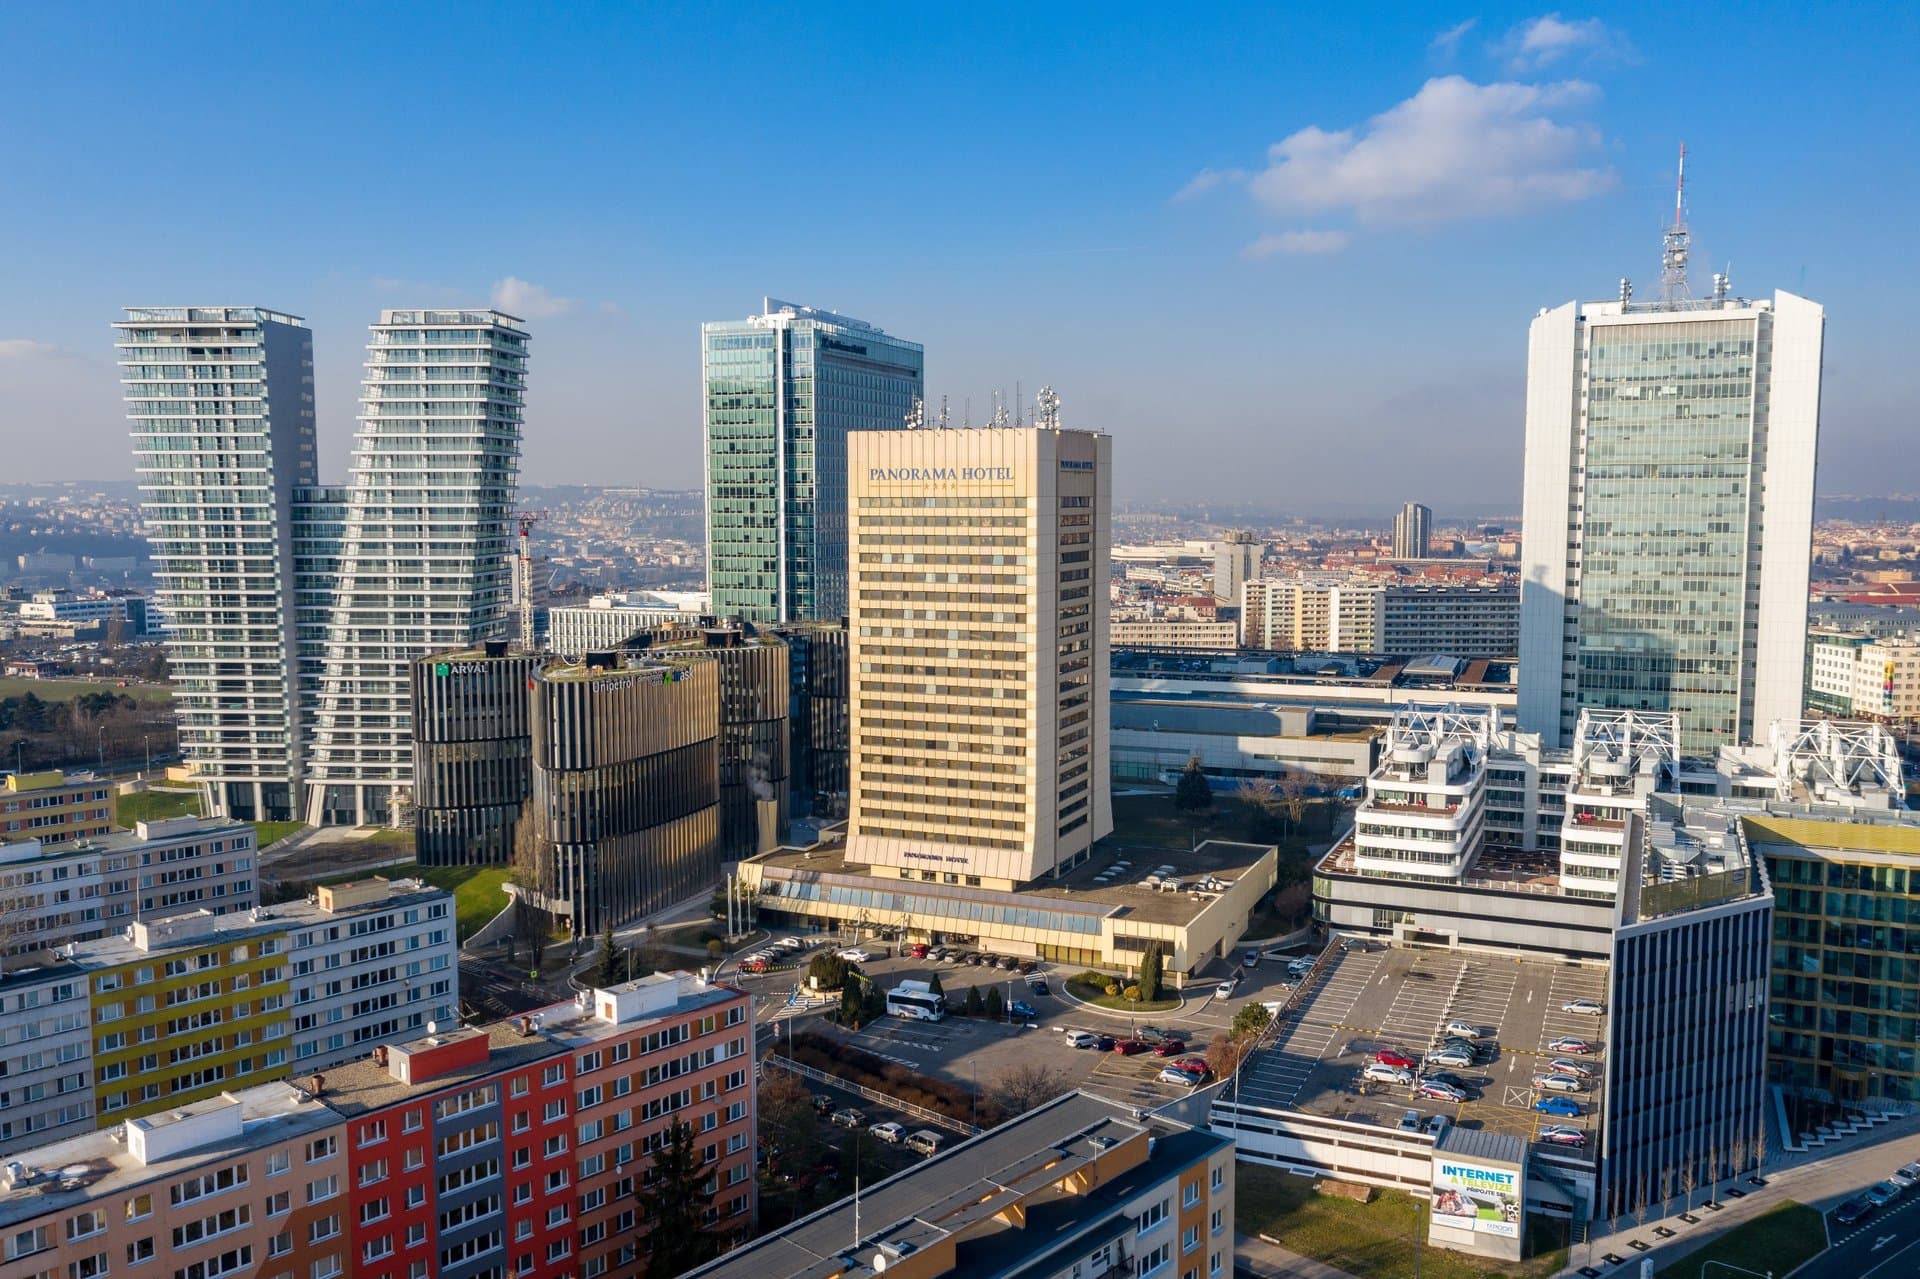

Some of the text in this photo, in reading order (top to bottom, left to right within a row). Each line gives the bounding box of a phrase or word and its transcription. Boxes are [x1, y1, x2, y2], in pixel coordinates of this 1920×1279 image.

[870, 467, 1014, 481] PANORAMA HOTEL
[451, 665, 488, 674] ARVAL
[592, 677, 634, 693] Unipetrol
[1442, 1165, 1514, 1184] INTERNET
[1451, 1176, 1513, 1192] A TELEVIZE
